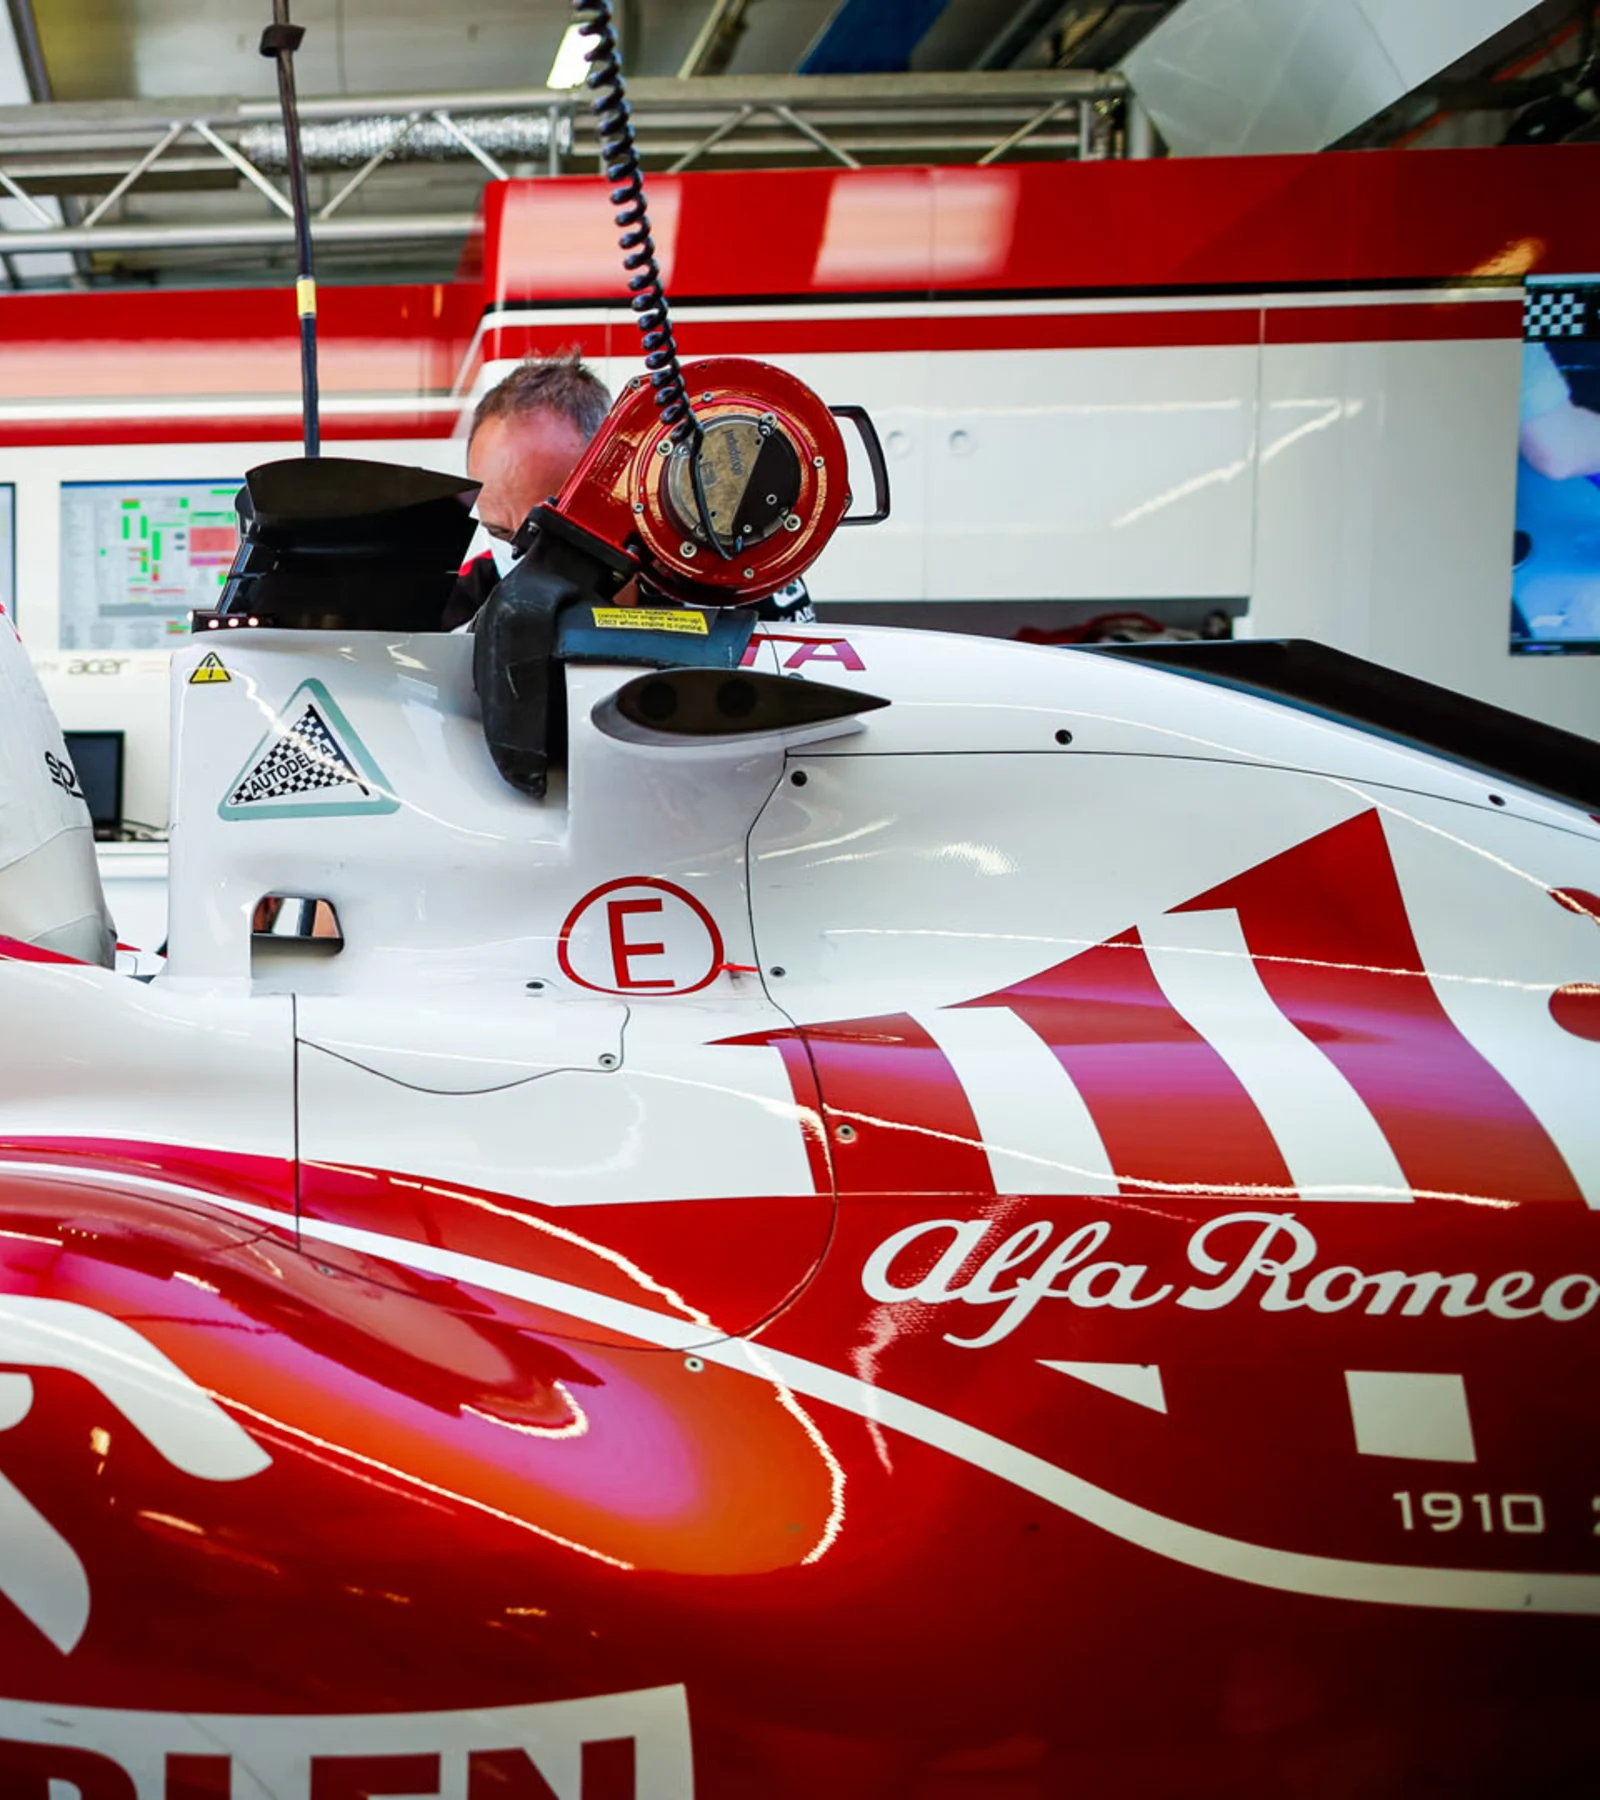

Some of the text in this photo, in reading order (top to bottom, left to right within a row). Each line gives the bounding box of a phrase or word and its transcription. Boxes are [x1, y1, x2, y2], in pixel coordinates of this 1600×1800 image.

[67, 657, 130, 675] acer
[251, 743, 334, 796] AUTODELA
[607, 898, 676, 988] E
[860, 1211, 1600, 1349] Alfa Romeo
[1392, 1490, 1545, 1534] 1910
